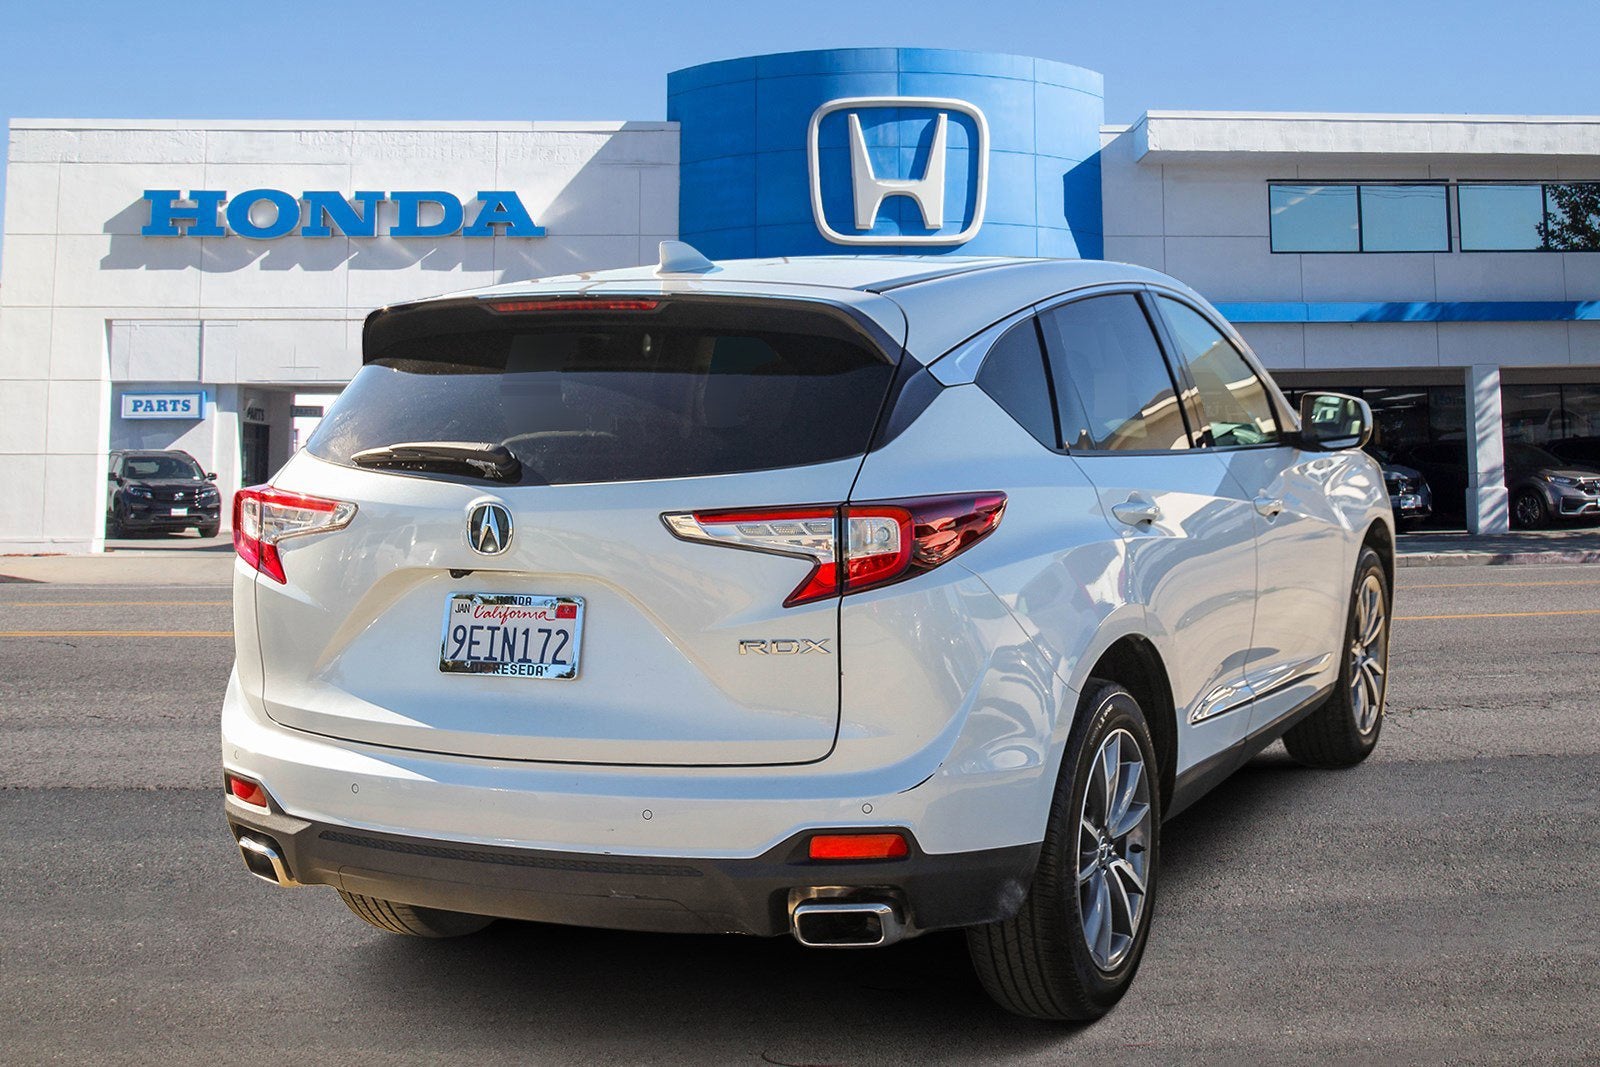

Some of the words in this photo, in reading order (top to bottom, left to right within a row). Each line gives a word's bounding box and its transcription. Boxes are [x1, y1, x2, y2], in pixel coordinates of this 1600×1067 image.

[141, 189, 547, 240] HONDA
[131, 399, 192, 413] PARTS
[455, 603, 470, 614] JAN
[473, 605, 555, 625] California
[449, 624, 570, 665] 9EIN172
[738, 638, 832, 655] RDX
[492, 663, 544, 676] RESEDA
